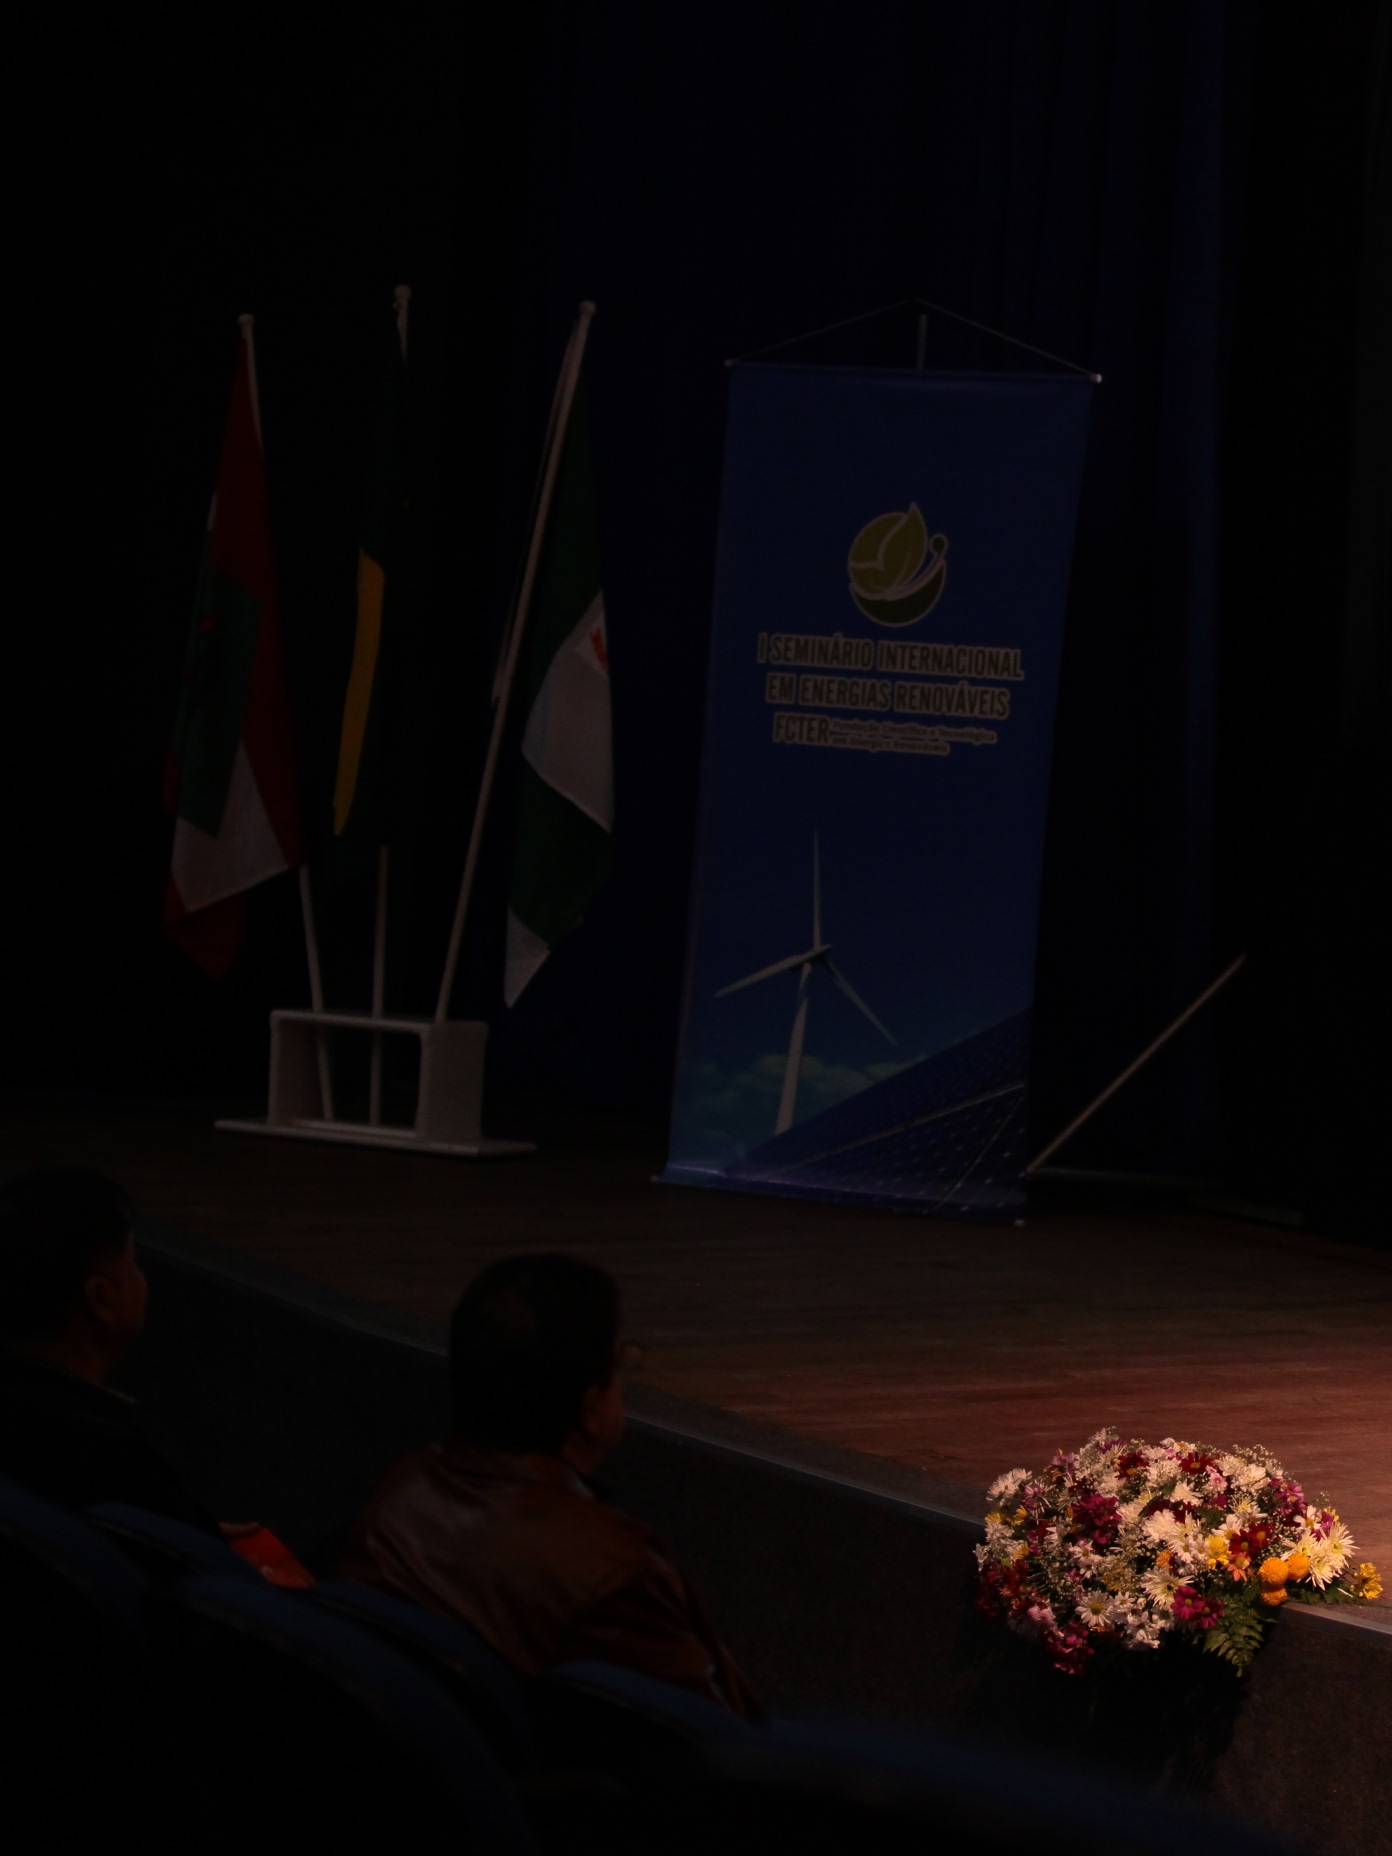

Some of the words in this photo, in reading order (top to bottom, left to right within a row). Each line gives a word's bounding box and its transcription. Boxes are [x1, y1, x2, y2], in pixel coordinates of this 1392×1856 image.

[758, 634, 767, 662] I
[771, 634, 872, 668] SEMINÁRIO
[878, 642, 1022, 679] INTERNACIONAL
[767, 674, 795, 703] EM
[800, 676, 889, 710] ENERGIAS
[895, 681, 1009, 718] RENOVÁVEIS
[775, 714, 829, 743] FCTER
